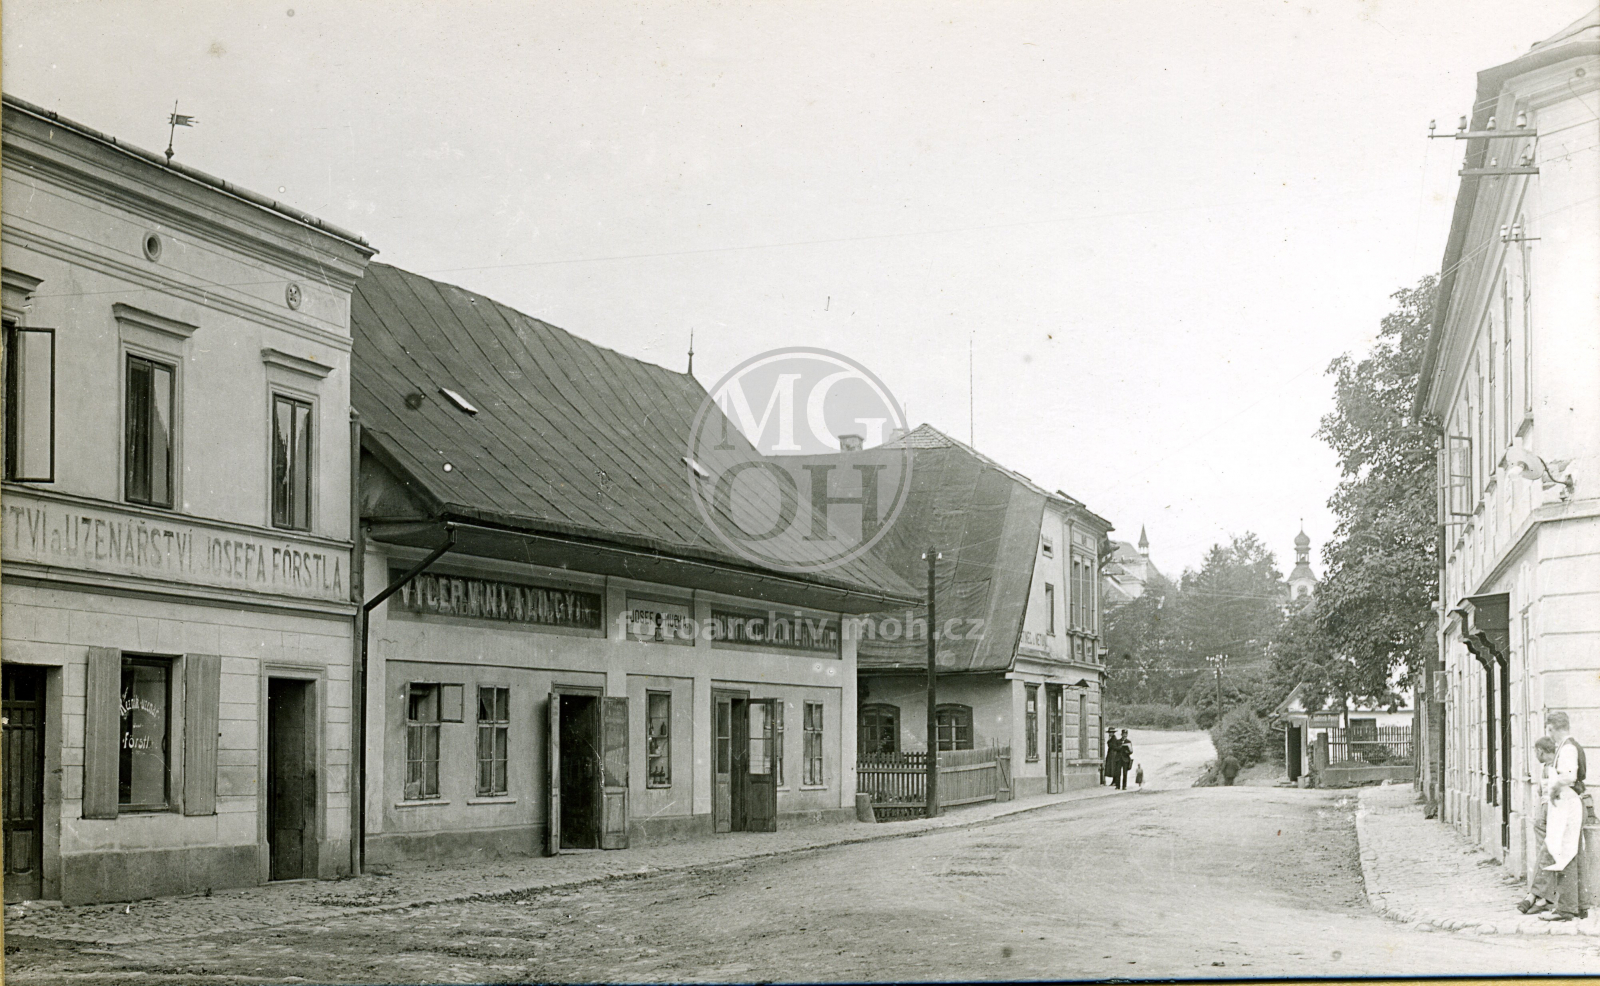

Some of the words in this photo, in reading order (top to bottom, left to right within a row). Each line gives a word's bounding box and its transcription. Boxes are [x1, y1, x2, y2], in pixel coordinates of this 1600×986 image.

[51, 528, 62, 556] a
[200, 536, 266, 583] JOSEFA
[630, 609, 654, 626] JOSEF
